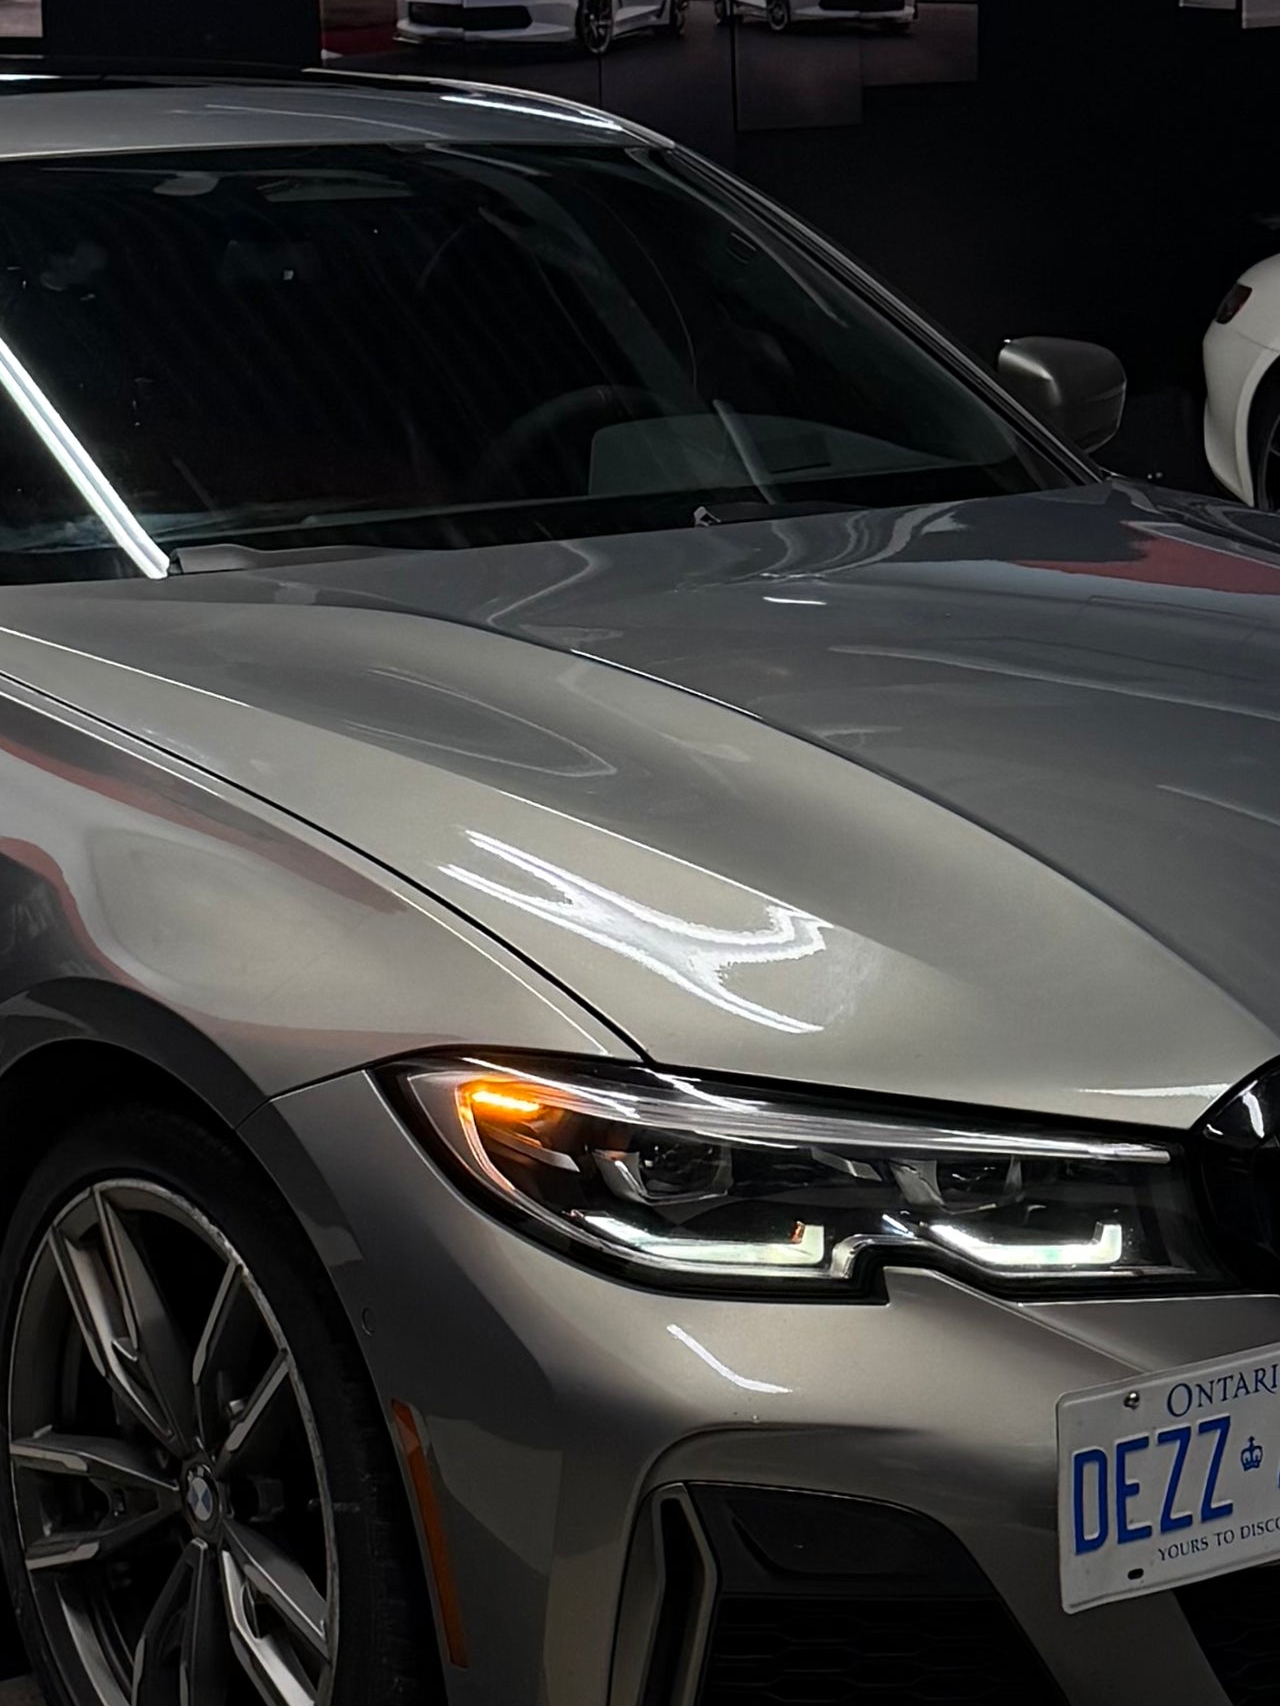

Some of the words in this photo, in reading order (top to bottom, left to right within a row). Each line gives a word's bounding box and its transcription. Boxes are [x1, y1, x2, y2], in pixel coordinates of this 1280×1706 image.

[1072, 1415, 1234, 1556] DEZZ
[1157, 1535, 1209, 1562] YOURS
[1214, 1528, 1235, 1547] TO
